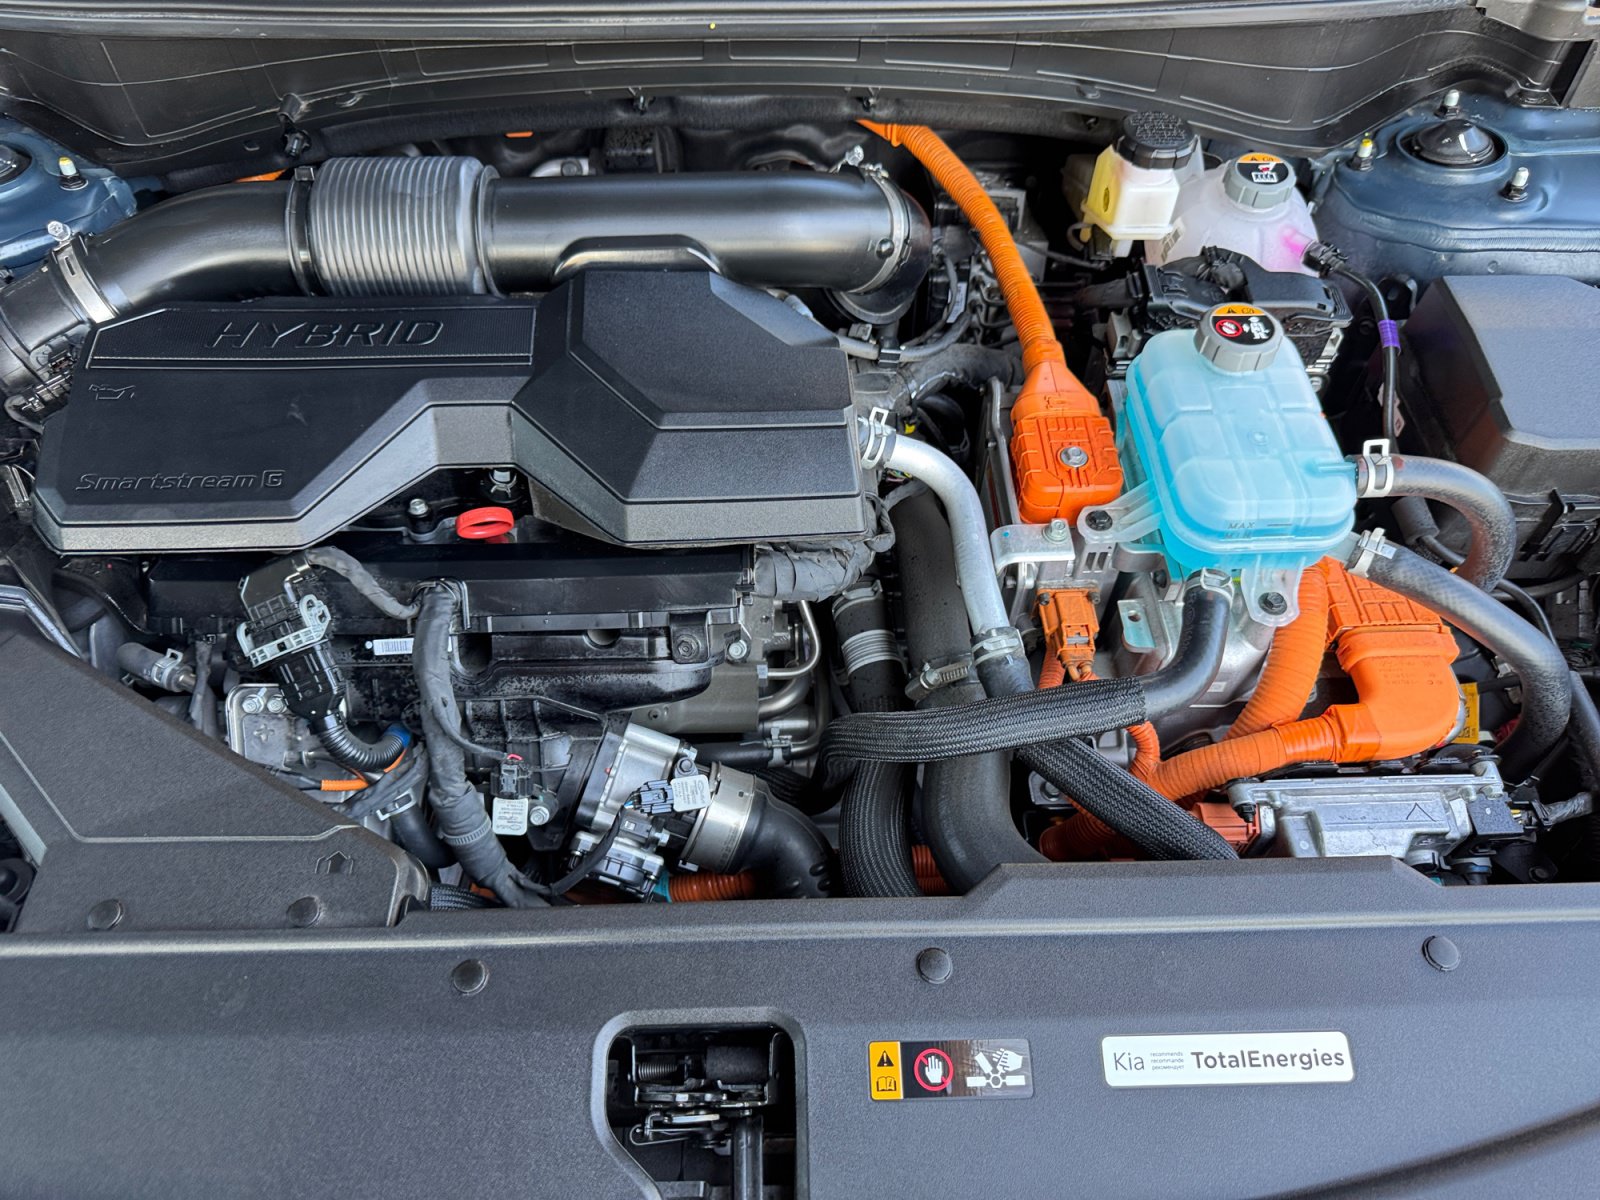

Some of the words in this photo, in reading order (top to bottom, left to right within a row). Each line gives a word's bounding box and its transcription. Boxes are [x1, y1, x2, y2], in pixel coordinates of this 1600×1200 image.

[208, 321, 444, 348] HYBRID
[75, 472, 257, 491] Smartstream
[1113, 1052, 1145, 1071] Kia
[1190, 1048, 1345, 1071] TotalEnergies
